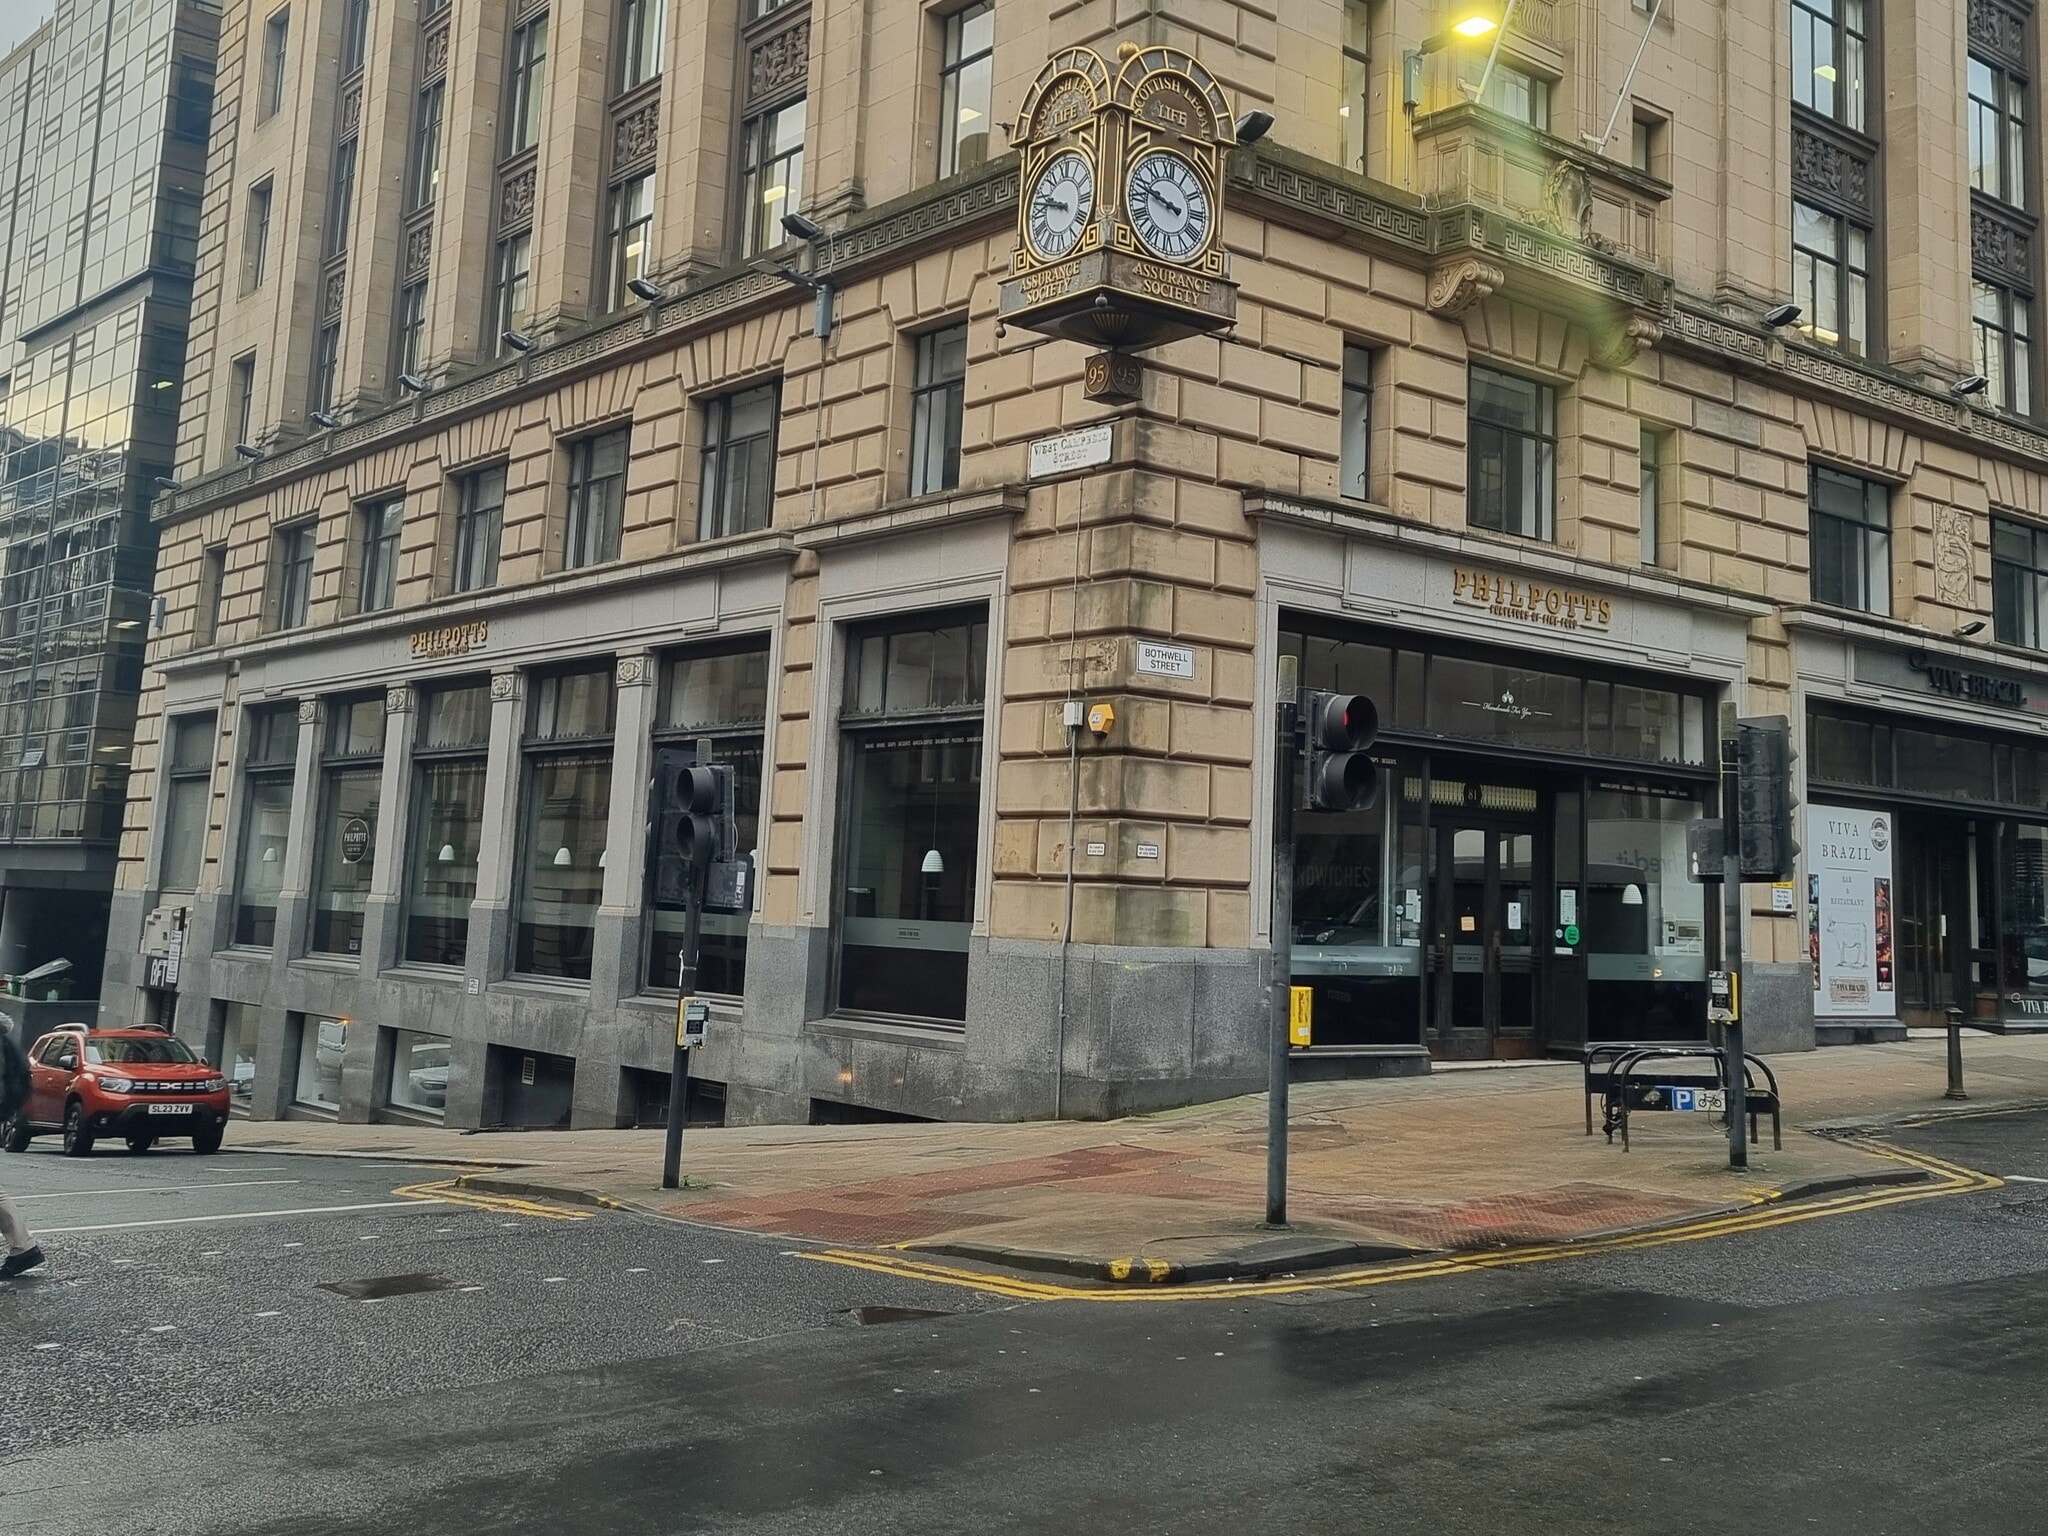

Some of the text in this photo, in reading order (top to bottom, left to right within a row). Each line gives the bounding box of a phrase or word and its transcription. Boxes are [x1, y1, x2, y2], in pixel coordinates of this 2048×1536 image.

[1054, 105, 1077, 125] LIFE
[1134, 78, 1211, 141] SCOTTISH LEGAL
[1158, 103, 1188, 127] LIFE
[1020, 260, 1080, 293] ASSURANCE
[1133, 263, 1212, 294] ASSURANCE
[1026, 277, 1072, 304] SOCIETY
[1143, 280, 1200, 305] SOCIETY
[1088, 365, 1104, 386] 95
[1117, 365, 1137, 385] 95
[1034, 443, 1058, 456] WEST
[1453, 568, 1612, 624] PHILPOTTS
[411, 620, 488, 653] PHILPOTTS
[1145, 648, 1189, 662] BOTHWELL
[1150, 659, 1181, 671] STREET
[1920, 662, 2027, 704] VIVA BRAZIL
[1467, 789, 1477, 801] 81
[344, 832, 366, 842] PHILPOTTS
[1829, 821, 1859, 837] VIVA
[1822, 844, 1871, 861] BRAZIL
[1830, 897, 1865, 906] RESTAURANT
[2016, 996, 2041, 1014] VIVA
[152, 1105, 190, 1113] SL23 ZVV
[1676, 1091, 1690, 1109] P
